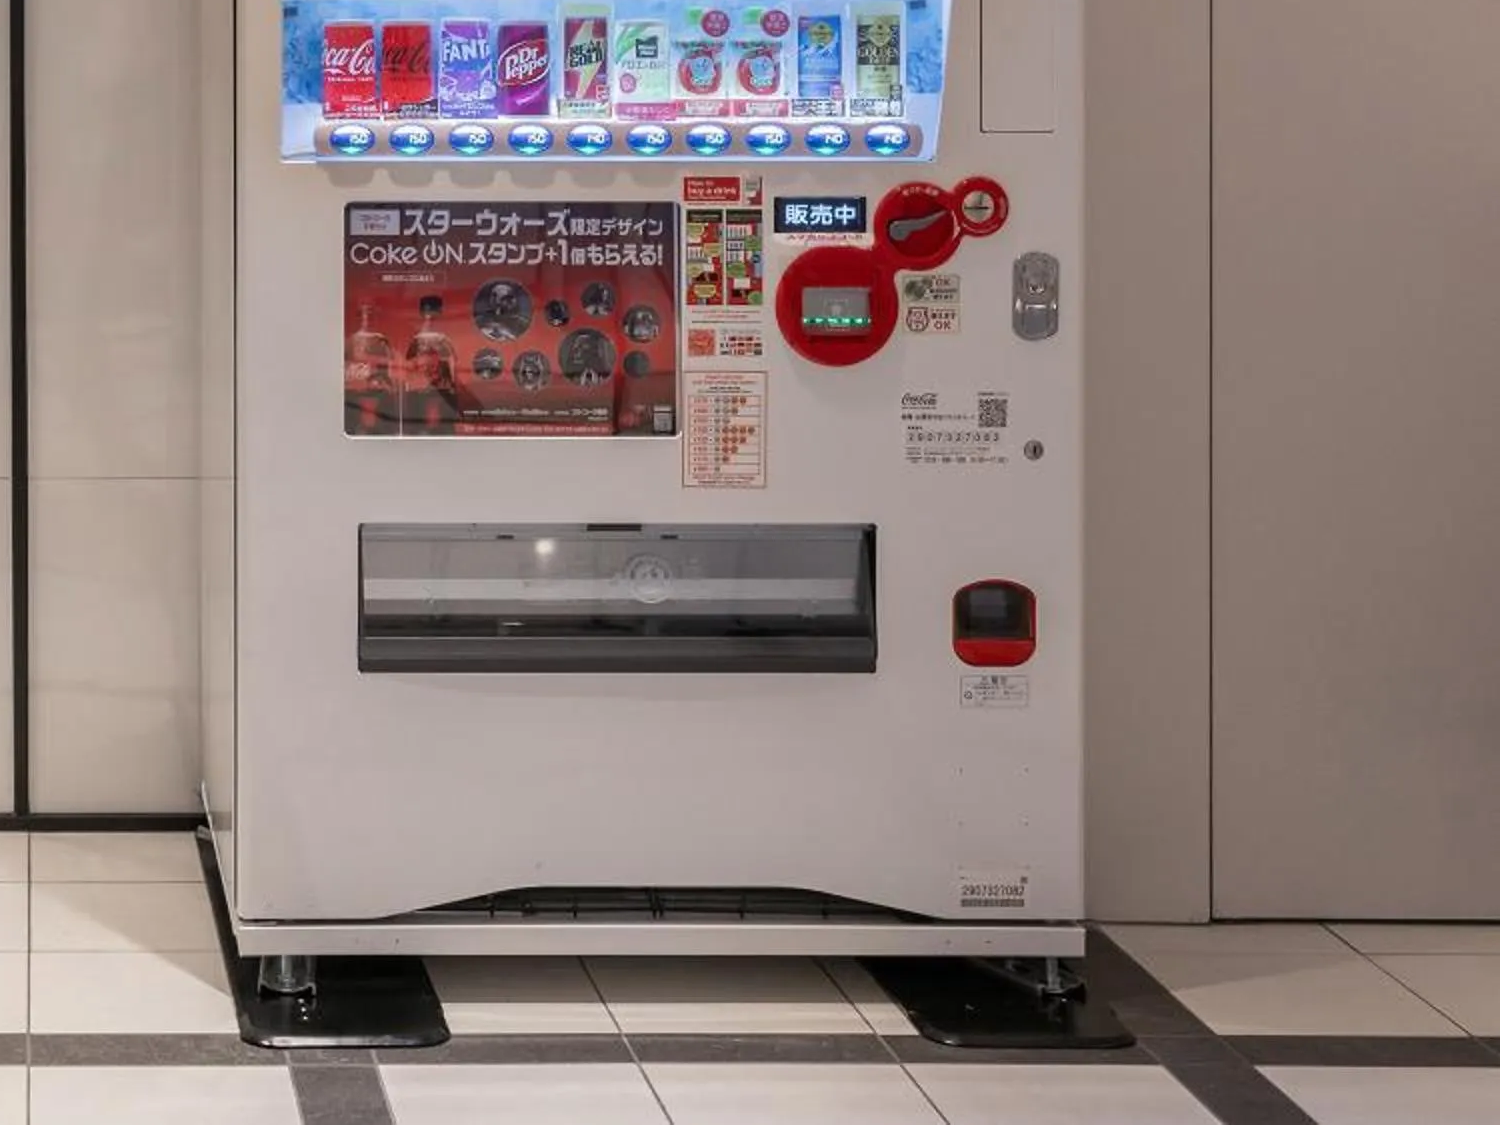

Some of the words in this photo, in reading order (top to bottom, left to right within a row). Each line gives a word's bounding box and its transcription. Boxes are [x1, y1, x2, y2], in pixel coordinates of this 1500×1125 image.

[785, 203, 857, 225] 販売中
[350, 242, 418, 265] Coke
